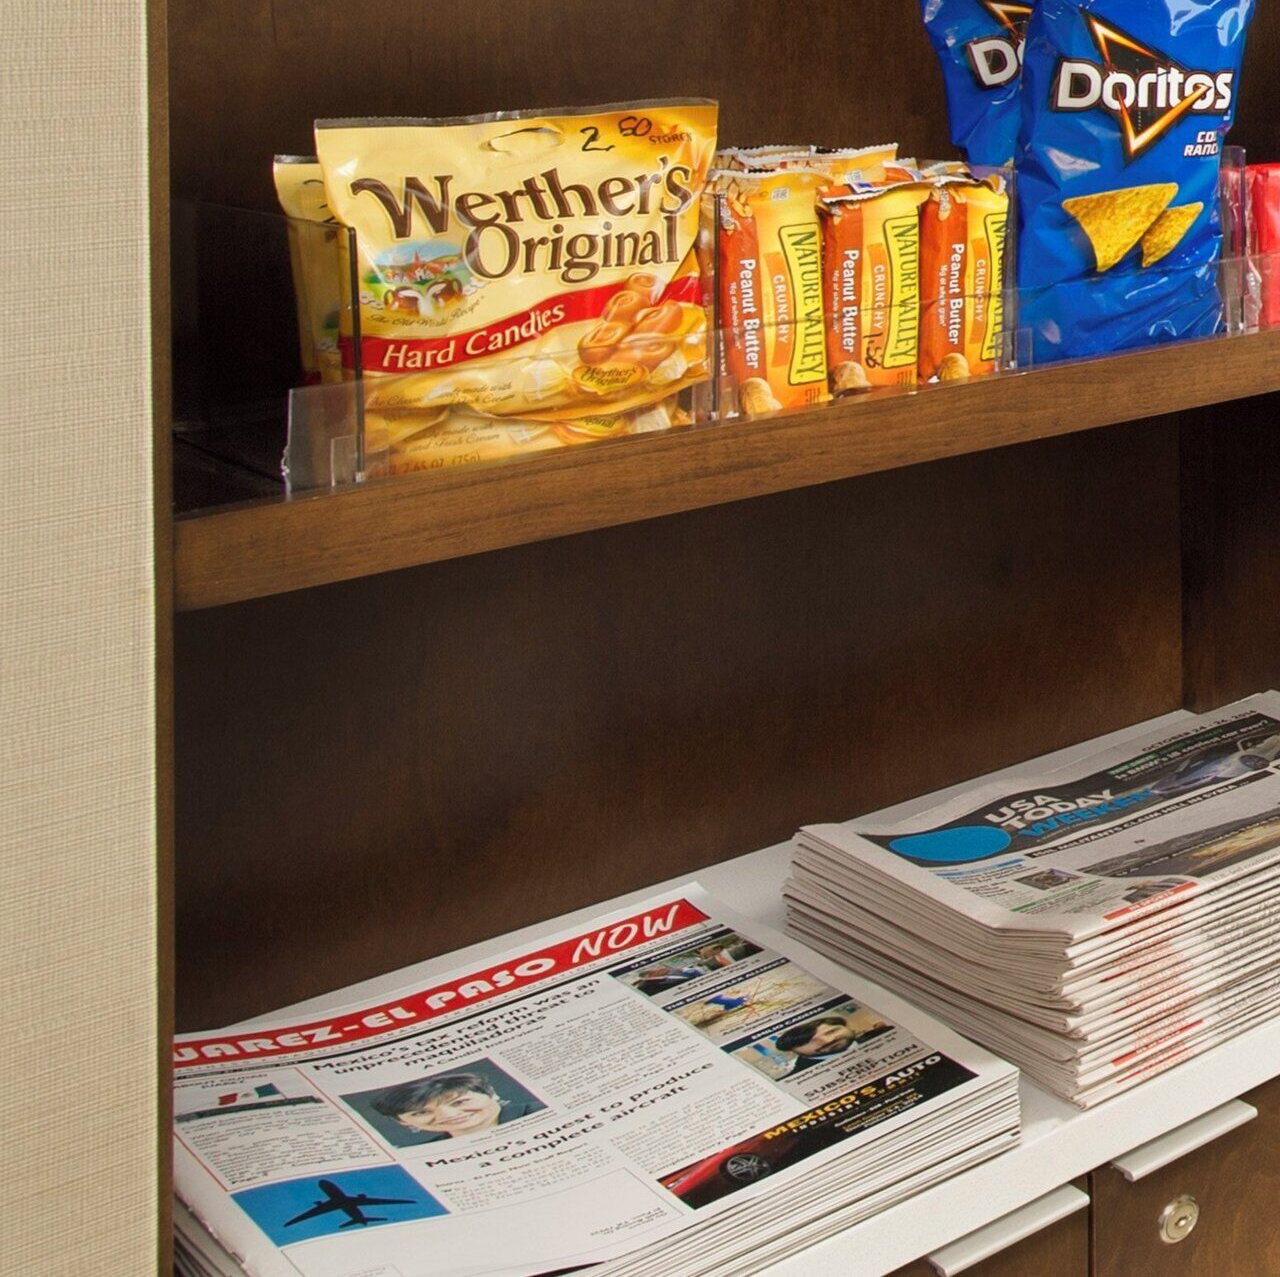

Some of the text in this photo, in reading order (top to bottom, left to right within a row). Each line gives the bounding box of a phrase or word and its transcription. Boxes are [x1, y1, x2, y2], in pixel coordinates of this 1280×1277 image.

[1054, 58, 1234, 112] Doritos
[580, 126, 615, 152] 2
[649, 131, 696, 144] STORCK
[350, 157, 692, 239] Werther's
[465, 215, 680, 284] Original
[739, 258, 760, 369] Peanut Butter
[773, 274, 789, 344] CRUNCHY
[787, 230, 825, 375] NATURE VALLEY
[842, 249, 859, 354] Peanut Butter
[874, 265, 886, 333] CRUNCHY
[890, 223, 919, 361] NATURE VALLEY
[949, 243, 964, 345] Peanut Butter
[974, 259, 986, 323] CRUNCHY
[383, 303, 567, 369] Hard Candies
[1142, 730, 1191, 752] OCTOBER
[985, 793, 1061, 824] USA
[1001, 788, 1118, 830] TODAY
[1126, 784, 1237, 829] CLAIM HILL SYRIA
[425, 903, 680, 1010] PASO NOW
[651, 935, 714, 962] AMBASSADOR
[312, 1045, 408, 1072] Mexico's
[415, 1032, 450, 1047] tax
[457, 1006, 530, 1034] reform
[534, 990, 573, 1006] was
[578, 978, 601, 990] an
[334, 1022, 501, 1074] unprecedented
[504, 998, 570, 1030] threat
[573, 987, 597, 1001] to
[404, 1014, 548, 1067] maquiladoras
[436, 1024, 544, 1065] Candid Interview
[751, 1005, 826, 1041] EMILIO CADENA
[763, 1083, 877, 1141] MEXICO'S
[884, 1054, 943, 1087] AUTO
[803, 1043, 919, 1099] SUBSCRIPTION
[838, 1057, 876, 1078] FREE
[424, 1136, 528, 1170] Mexico's
[532, 1114, 596, 1143] quest
[601, 1101, 624, 1113] to
[629, 1061, 715, 1105] produce
[478, 1161, 493, 1170] a
[499, 1122, 605, 1163] complete
[609, 1082, 690, 1123] aircraft
